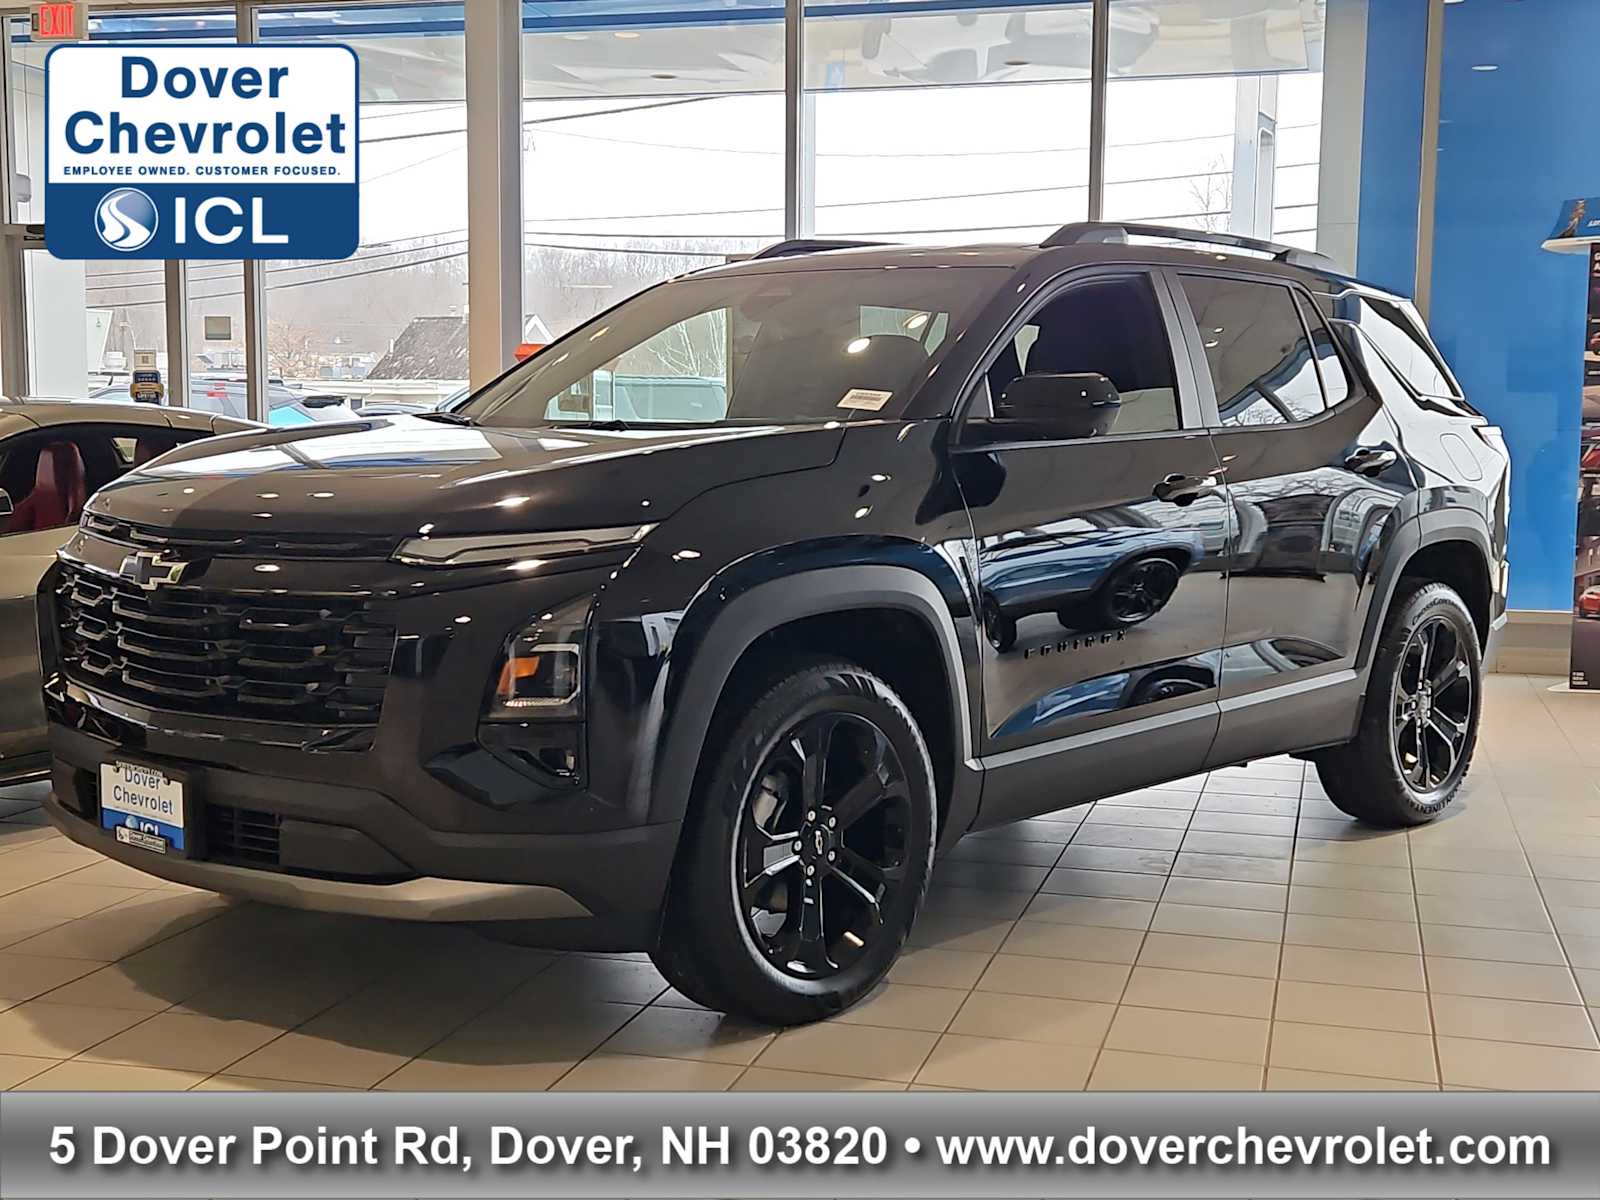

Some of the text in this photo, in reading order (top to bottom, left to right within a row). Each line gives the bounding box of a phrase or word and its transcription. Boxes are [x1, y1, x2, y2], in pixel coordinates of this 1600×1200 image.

[40, 4, 74, 36] EXIT
[124, 768, 161, 790] Dover
[113, 785, 174, 815] Chevrolet
